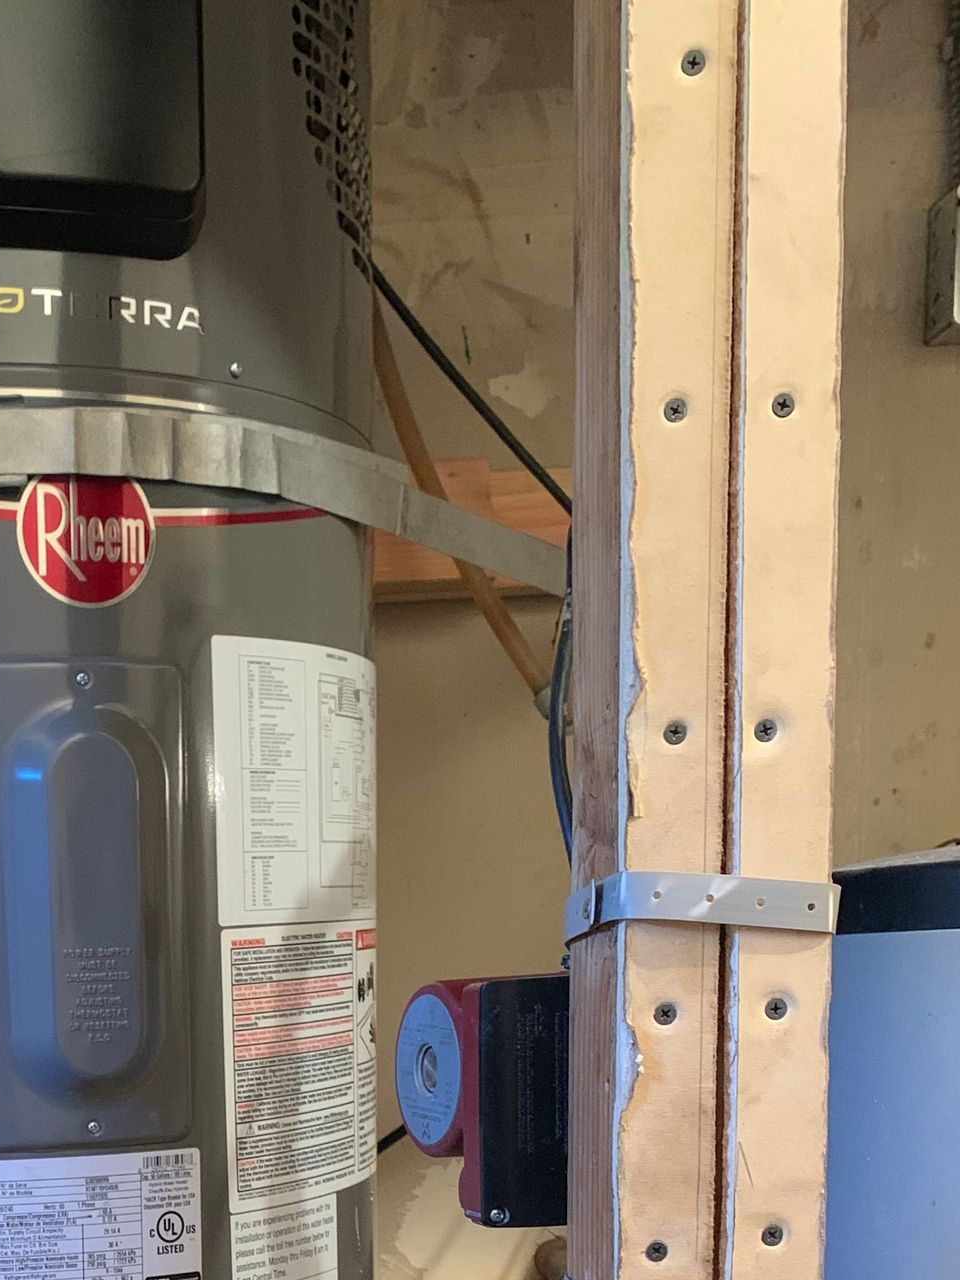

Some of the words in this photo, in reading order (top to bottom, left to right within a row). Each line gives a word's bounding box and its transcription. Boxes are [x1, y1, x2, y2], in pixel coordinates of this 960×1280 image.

[37, 480, 148, 582] Rheem
[231, 938, 265, 947] WARNING
[163, 1218, 178, 1236] UL
[186, 1225, 196, 1234] US
[241, 1222, 251, 1231] you
[263, 1213, 294, 1226] experiencing
[296, 1208, 315, 1219] problems
[235, 1232, 265, 1244] installation
[273, 1226, 296, 1237] operation
[157, 1244, 184, 1255] LISTED
[236, 1249, 255, 1259] please
[256, 1245, 265, 1255] call
[295, 1236, 311, 1246] number
[269, 1255, 289, 1265] Monday
